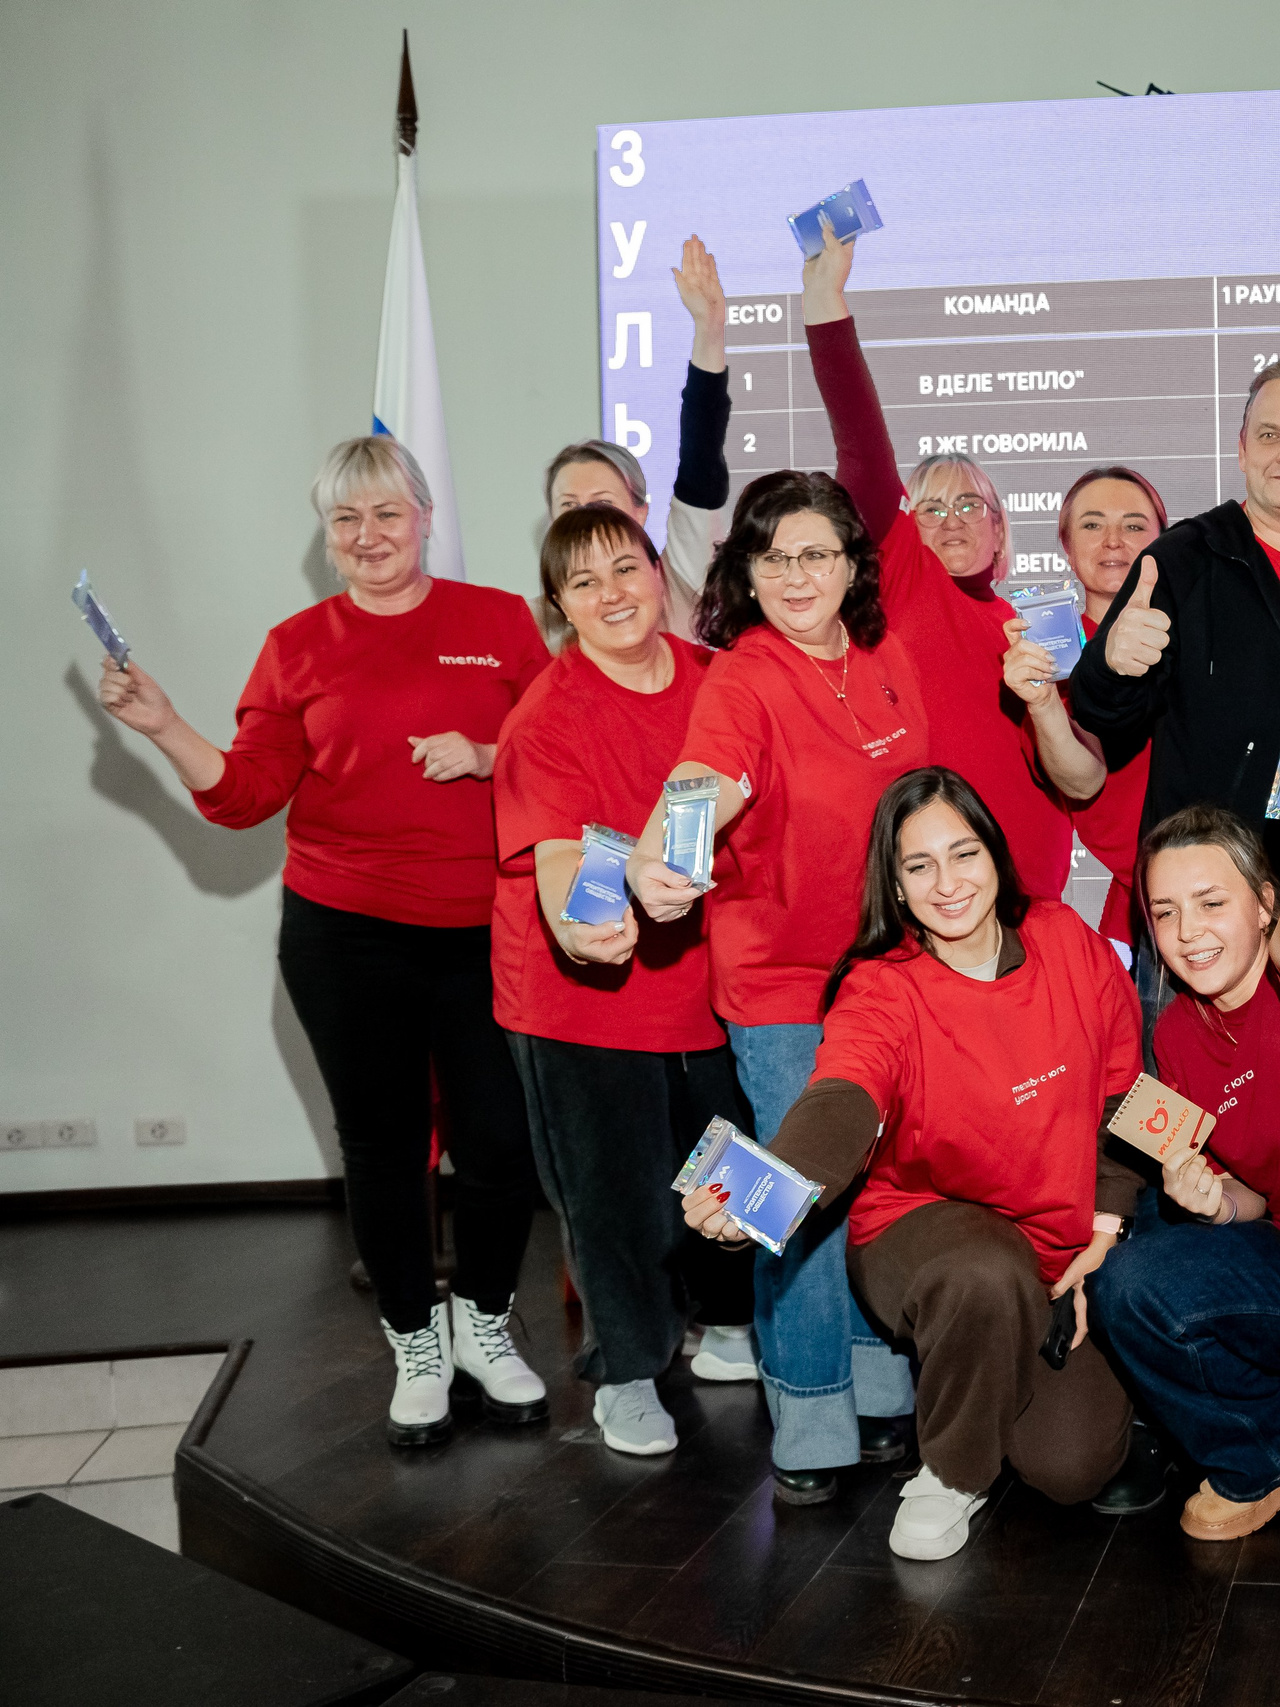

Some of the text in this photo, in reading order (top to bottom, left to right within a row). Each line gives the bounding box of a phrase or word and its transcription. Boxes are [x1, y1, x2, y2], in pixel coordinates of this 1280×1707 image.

[944, 292, 1050, 316] КОМАНДА
[1222, 285, 1232, 305] 1
[725, 303, 783, 325] ЕСТО
[743, 372, 753, 391] 1
[919, 370, 1085, 397] В ДЕЛЕ "ТЕПЛО"
[743, 433, 757, 453] 2
[918, 431, 1089, 456] Я ЖЕ ГОВОРИЛА
[438, 653, 503, 668] тепло
[1230, 1069, 1255, 1089] юга
